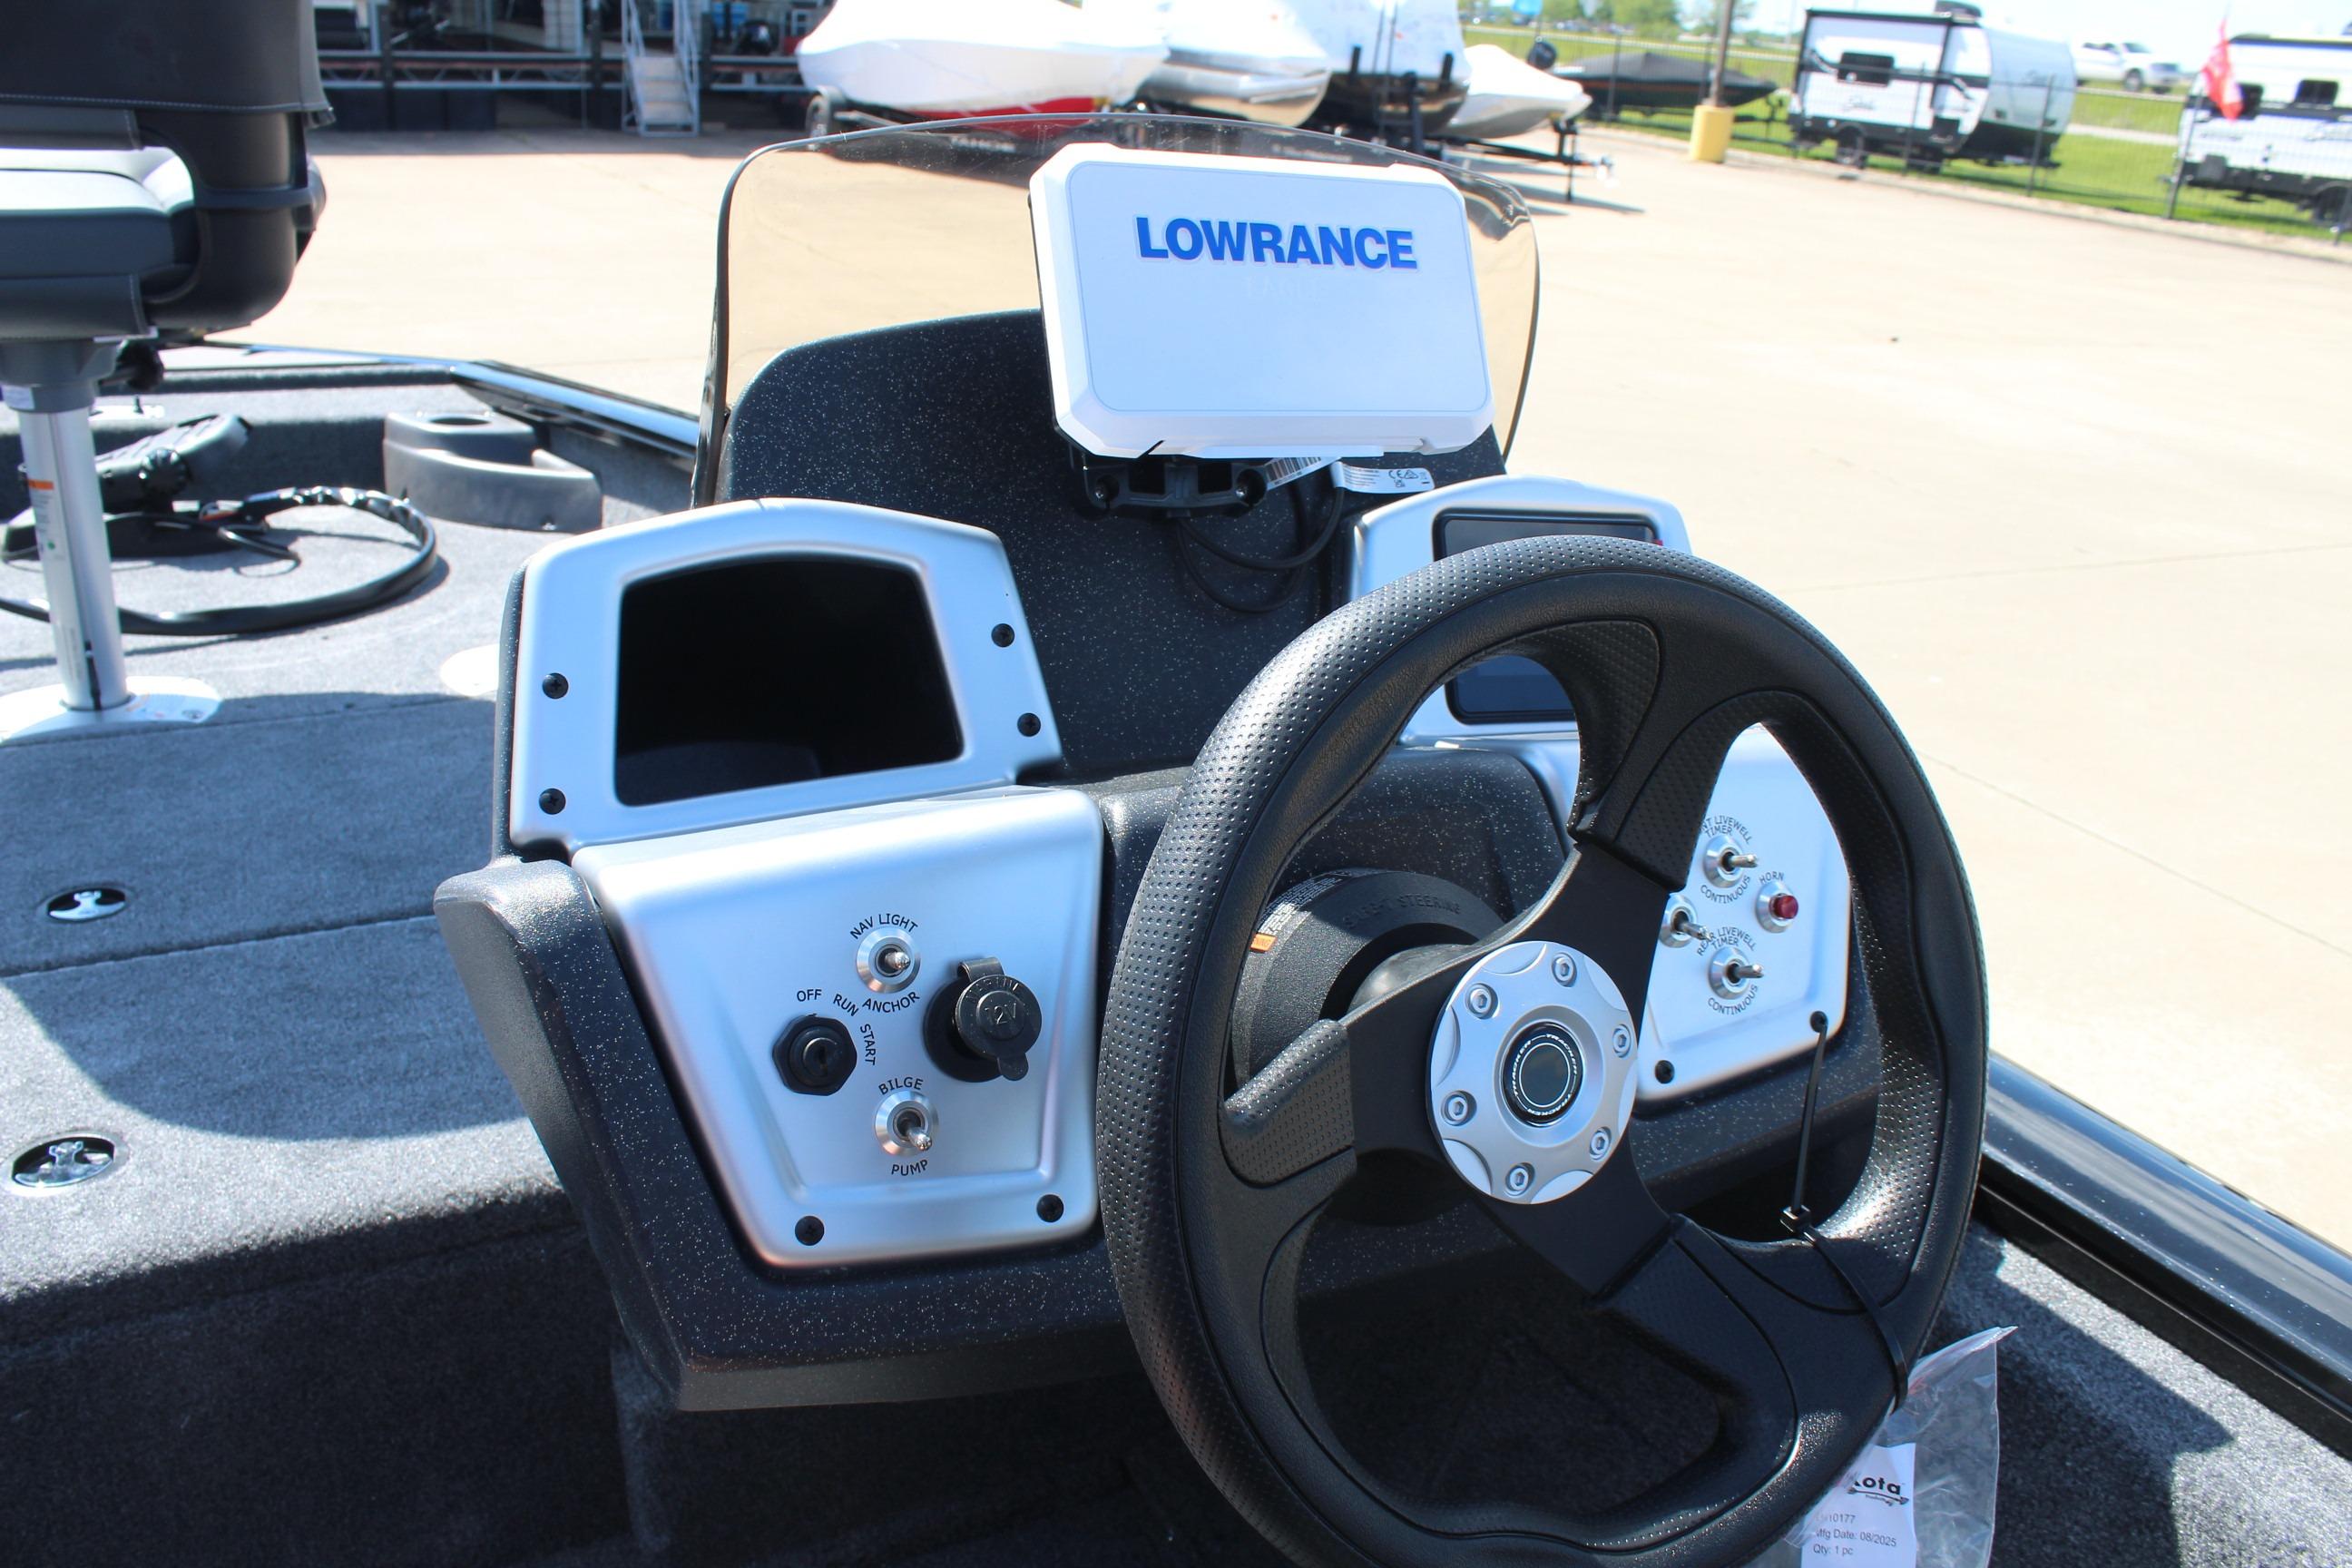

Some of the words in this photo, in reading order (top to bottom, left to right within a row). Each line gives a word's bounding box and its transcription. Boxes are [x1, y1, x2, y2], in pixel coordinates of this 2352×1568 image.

[1135, 216, 1418, 270] LOWRANCE
[1705, 825, 1733, 838] TIMER
[1714, 815, 1752, 845] LIVEWELL
[1759, 870, 1785, 885] HORN
[1700, 875, 1750, 904] CONTINUOUS
[849, 916, 874, 939] NAV
[878, 913, 918, 933] LIGHT
[1697, 932, 1717, 956] REAR
[1718, 926, 1757, 951] LIVEWELL
[1711, 936, 1740, 950] TIMER
[797, 988, 822, 1002] OFF
[833, 993, 859, 1016] RUN
[862, 991, 920, 1013] ANCHOR
[1708, 985, 1759, 1015] CONTINUOUS
[859, 1024, 877, 1065] START
[878, 1076, 924, 1095] BILGE
[891, 1159, 928, 1177] PUMP
[1854, 1476, 1901, 1495] ota
[1859, 1531, 1897, 1547] 08/2025
[1813, 1544, 1831, 1555] Qty:
[1835, 1545, 1839, 1554] 1
[1842, 1547, 1854, 1557] pc
